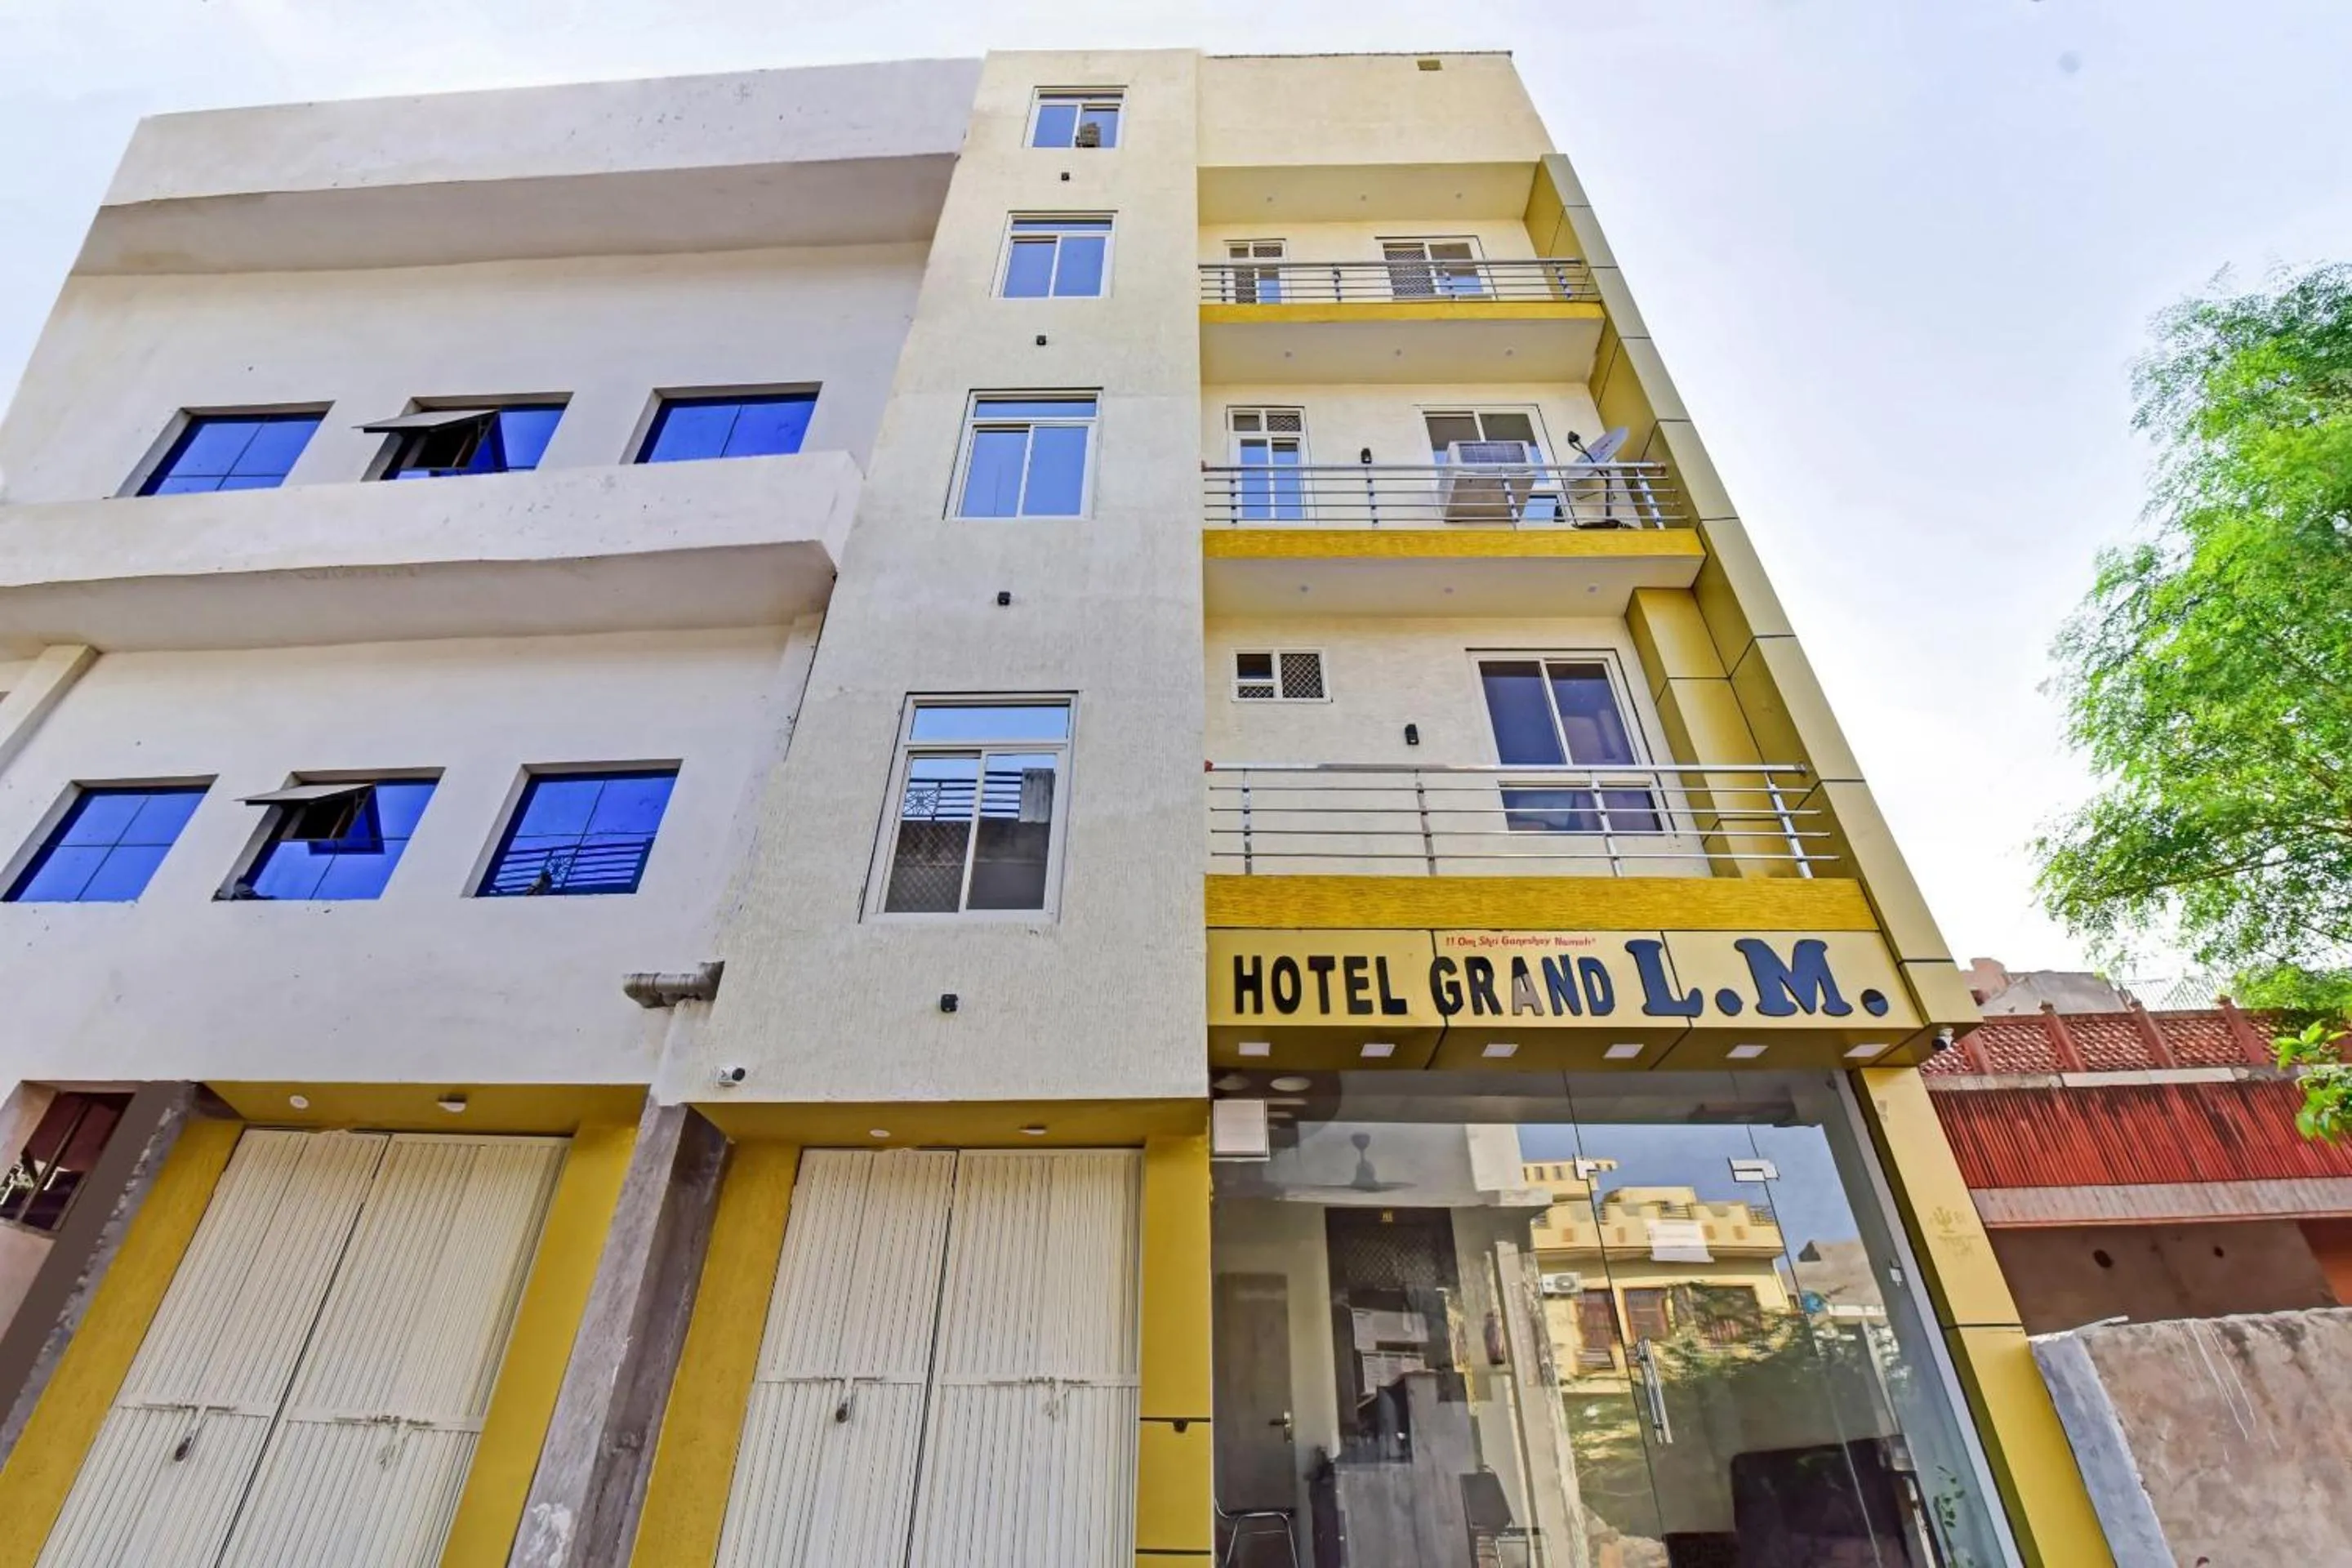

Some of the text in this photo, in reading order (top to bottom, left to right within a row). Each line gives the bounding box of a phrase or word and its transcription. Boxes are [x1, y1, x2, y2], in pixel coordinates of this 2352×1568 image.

[1233, 938, 1889, 1018] HOTEL GRAND L.M.
